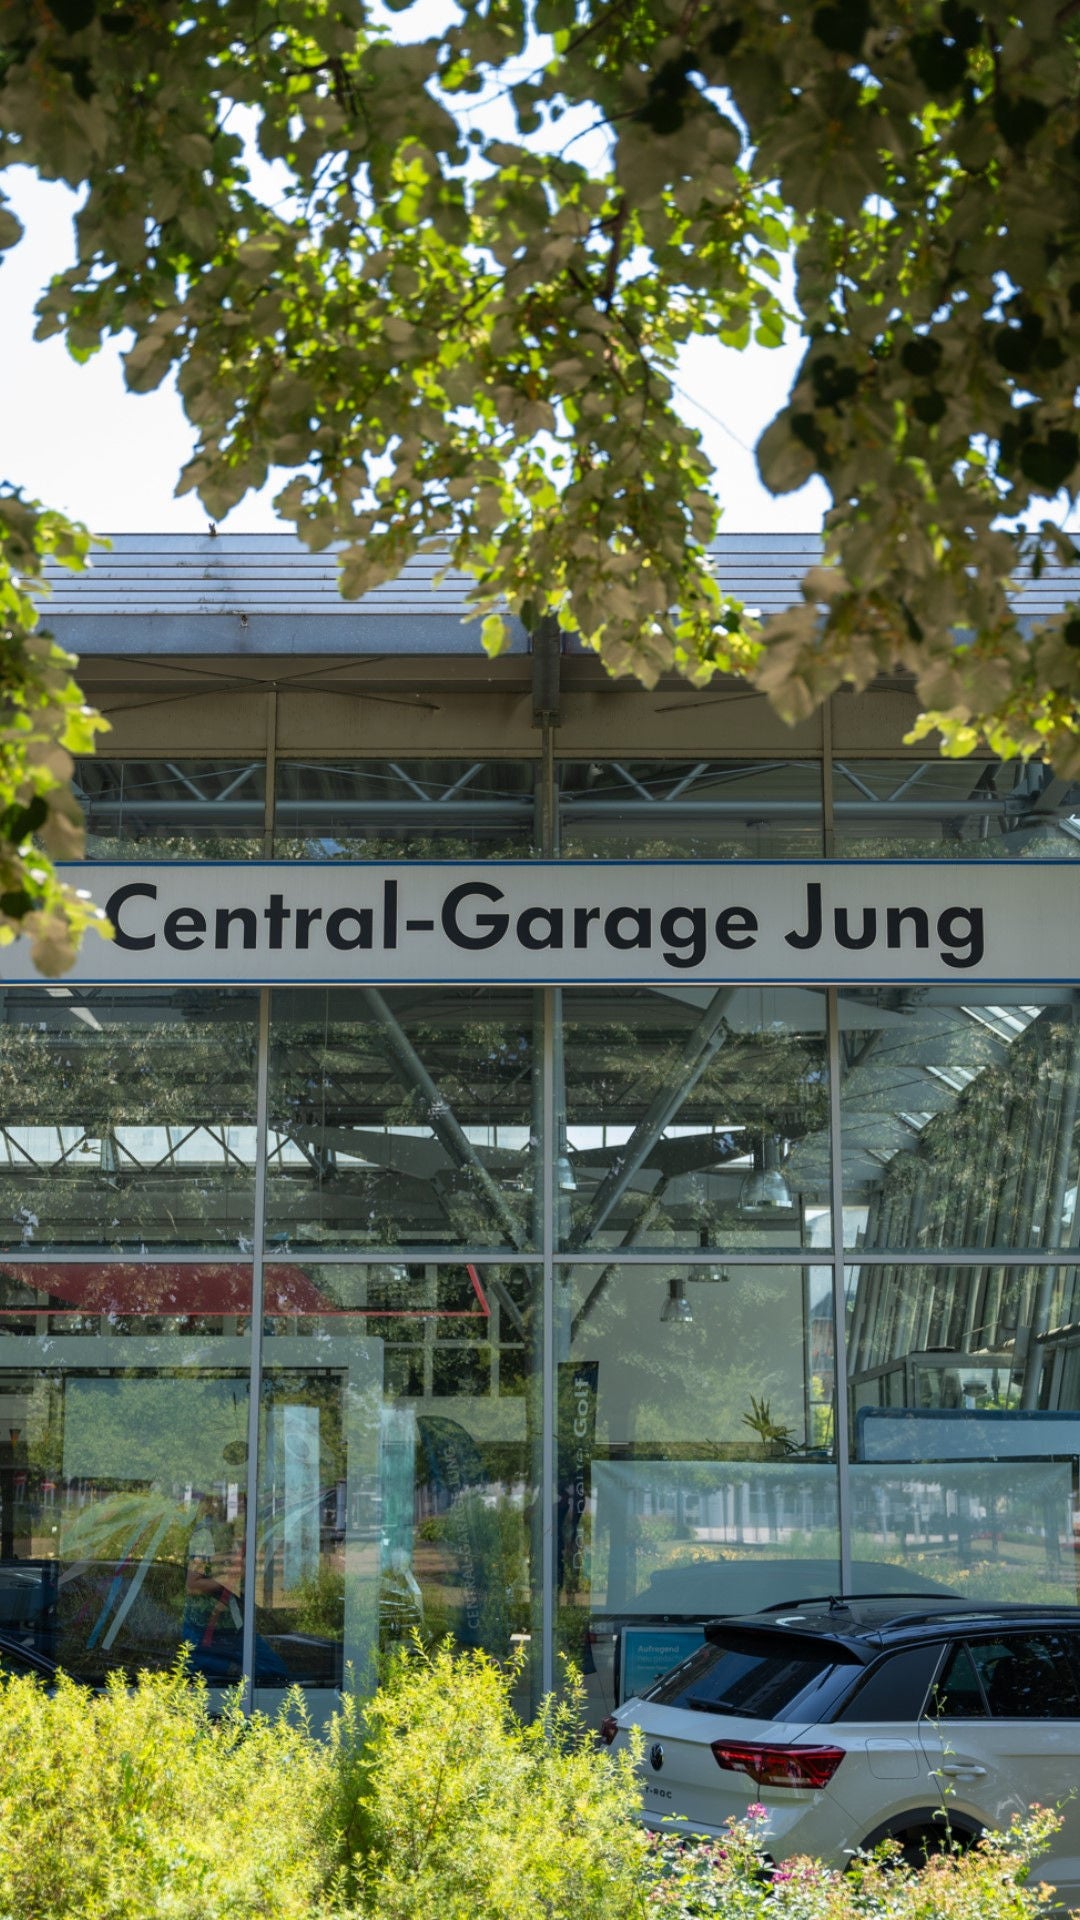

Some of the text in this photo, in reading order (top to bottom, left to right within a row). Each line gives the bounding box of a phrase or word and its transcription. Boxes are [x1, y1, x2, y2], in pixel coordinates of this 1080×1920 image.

[104, 880, 984, 968] Central-Garage Jung
[573, 1378, 589, 1438] Golf
[453, 1491, 480, 1630] CENTRAL-GARAG
